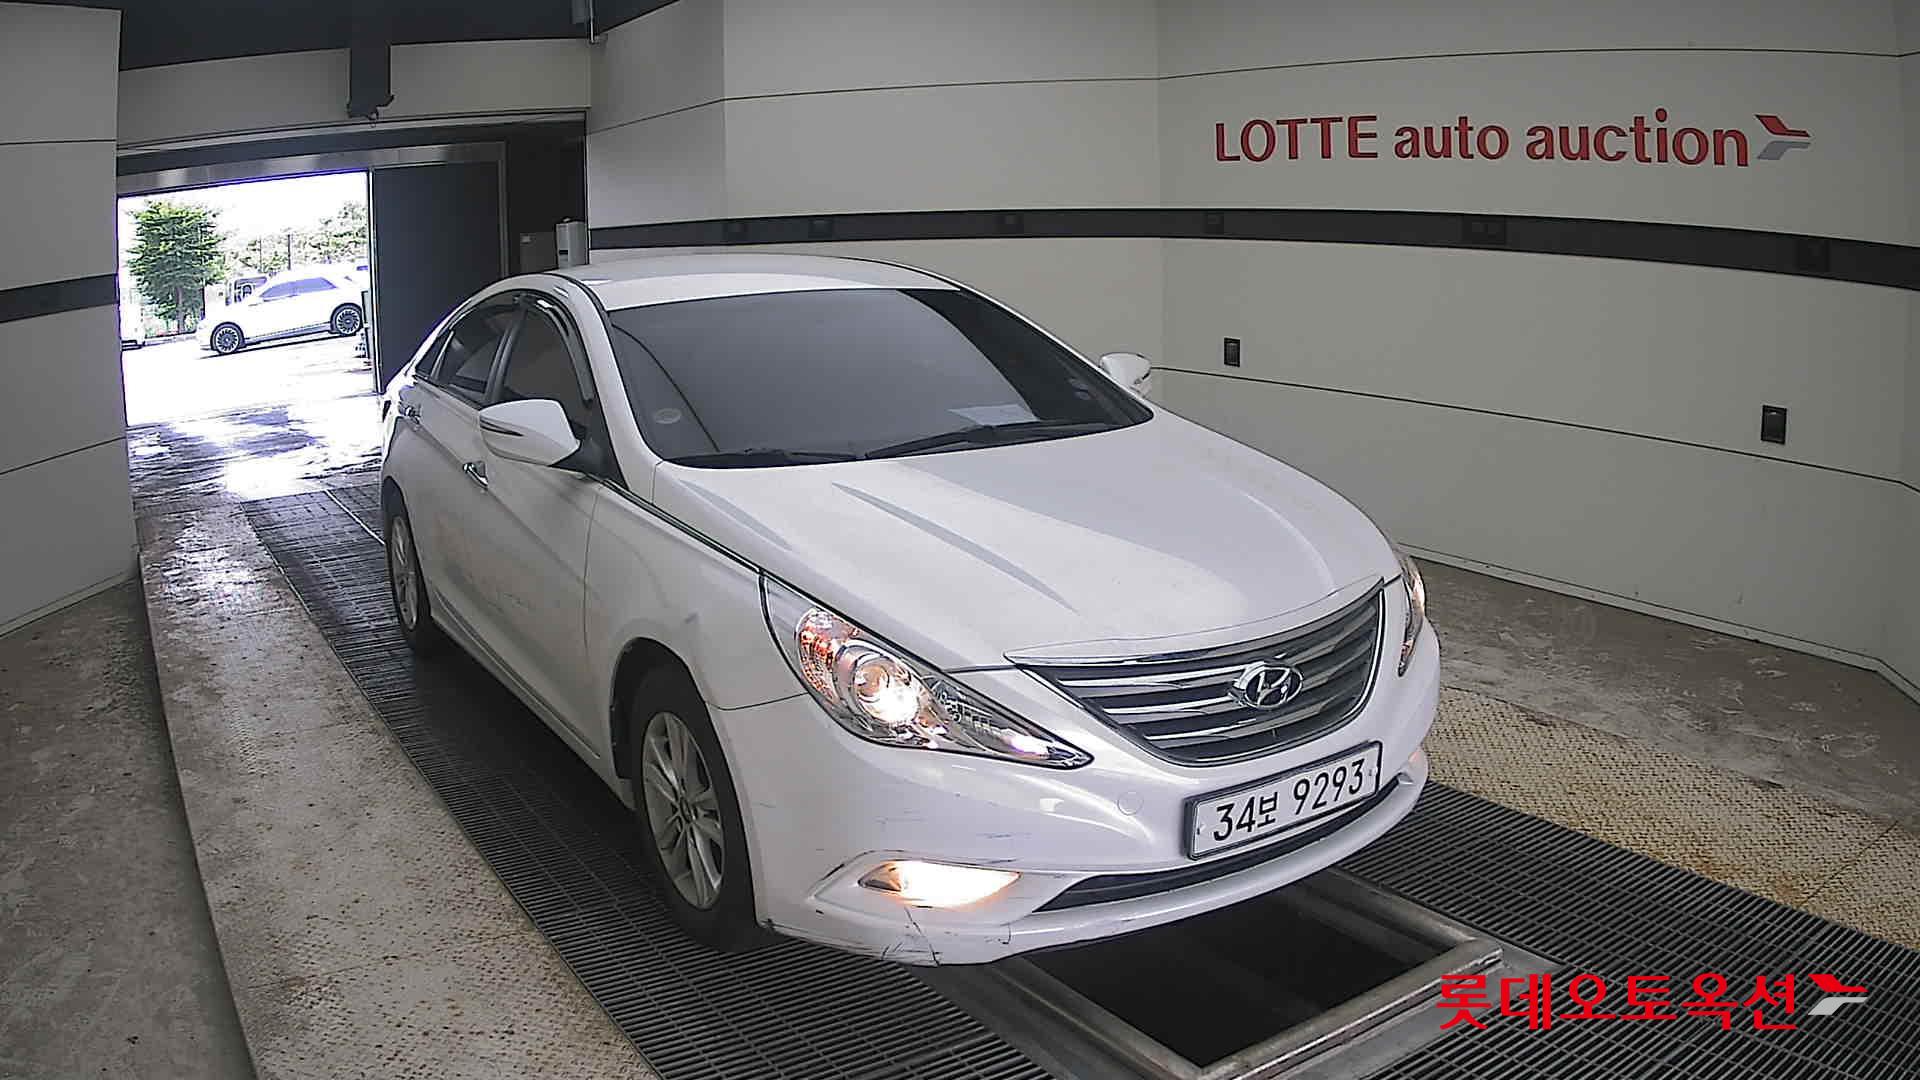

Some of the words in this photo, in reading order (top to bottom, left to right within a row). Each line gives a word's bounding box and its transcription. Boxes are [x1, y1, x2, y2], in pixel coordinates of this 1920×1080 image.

[1215, 115, 1379, 162] LOTTE
[1394, 116, 1510, 160] auto
[1525, 108, 1750, 167] auction
[1213, 791, 1278, 841] 34보
[1293, 758, 1366, 815] 9293
